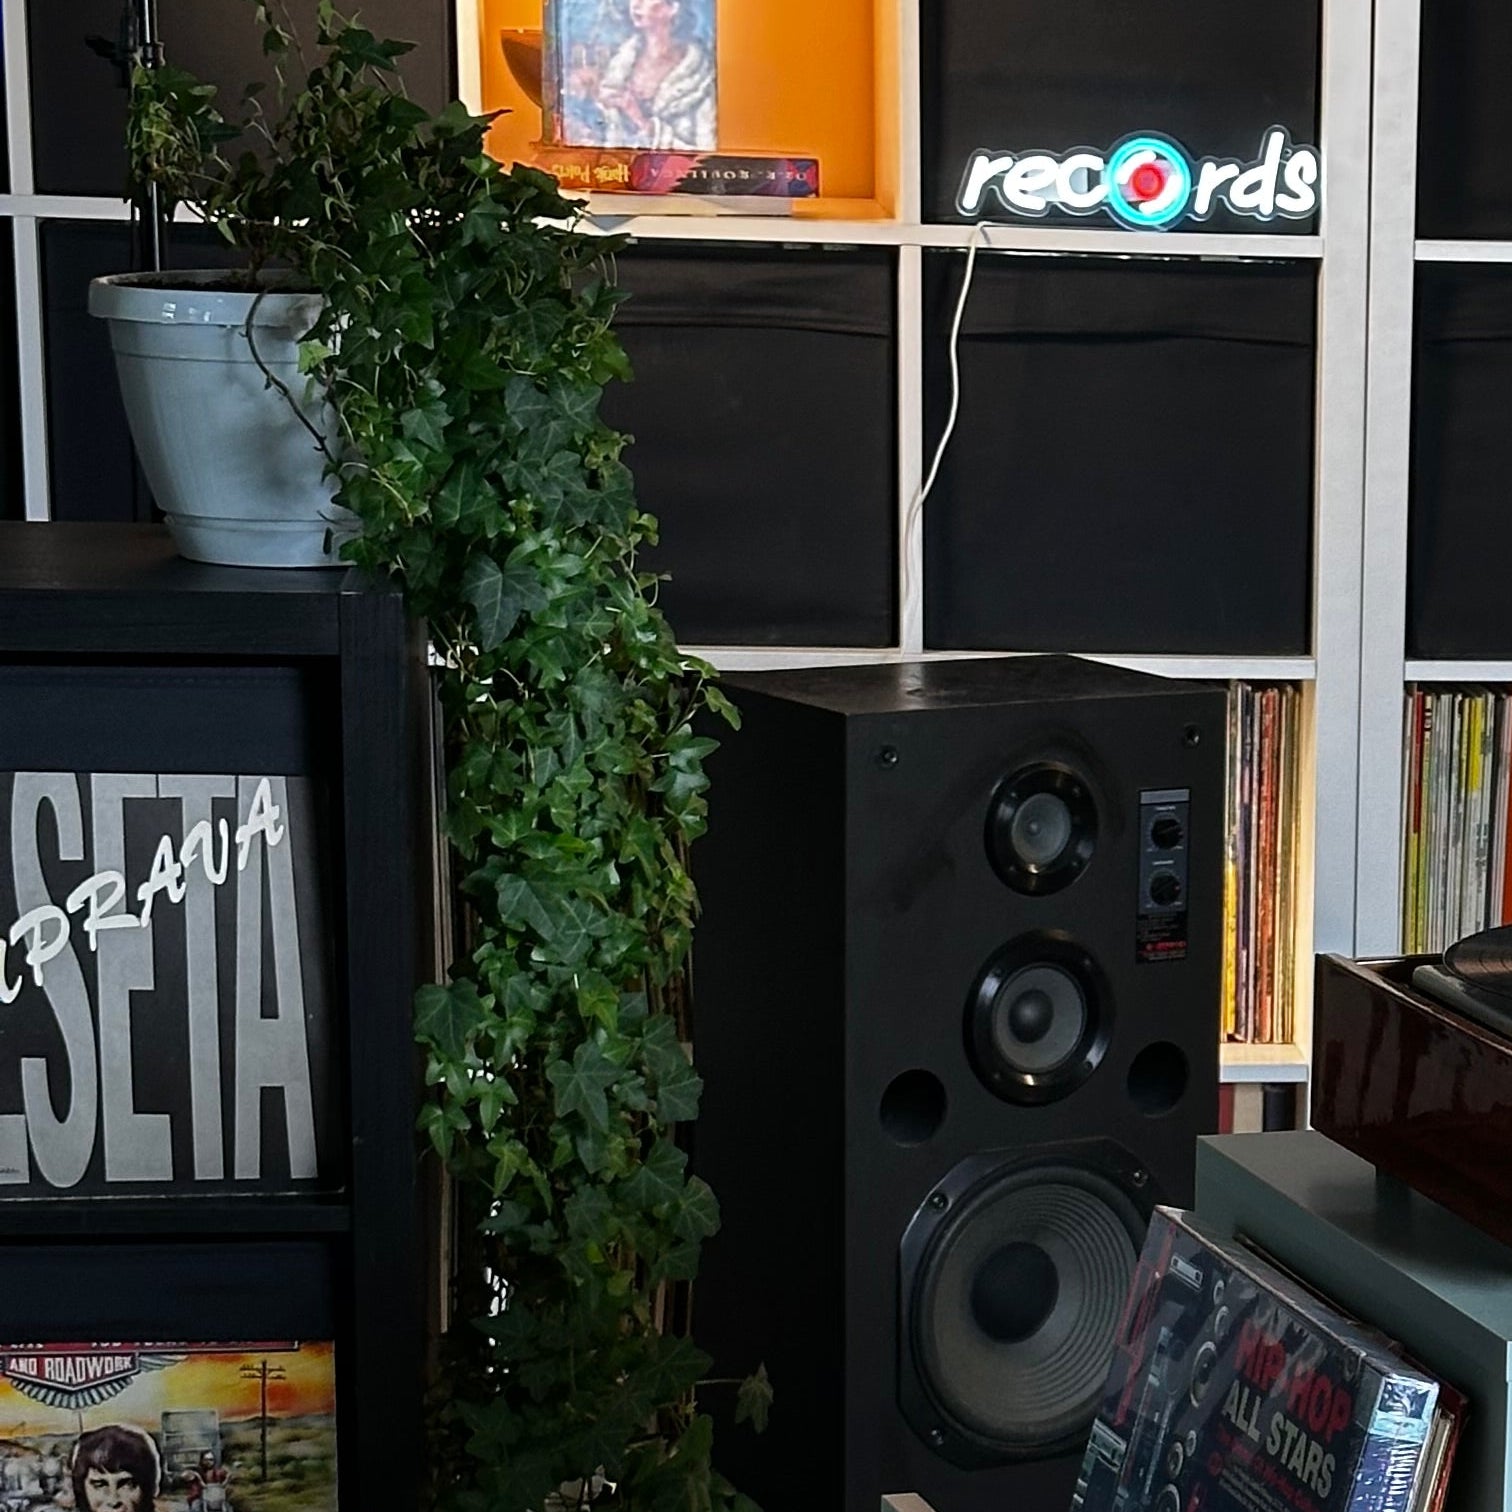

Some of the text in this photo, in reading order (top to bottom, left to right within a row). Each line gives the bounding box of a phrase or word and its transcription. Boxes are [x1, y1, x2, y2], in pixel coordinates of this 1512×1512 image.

[962, 131, 1318, 226] records
[44, 1354, 133, 1384] ROADWORK
[1222, 1379, 1262, 1443] ALL
[1266, 1411, 1336, 1499] STARS
